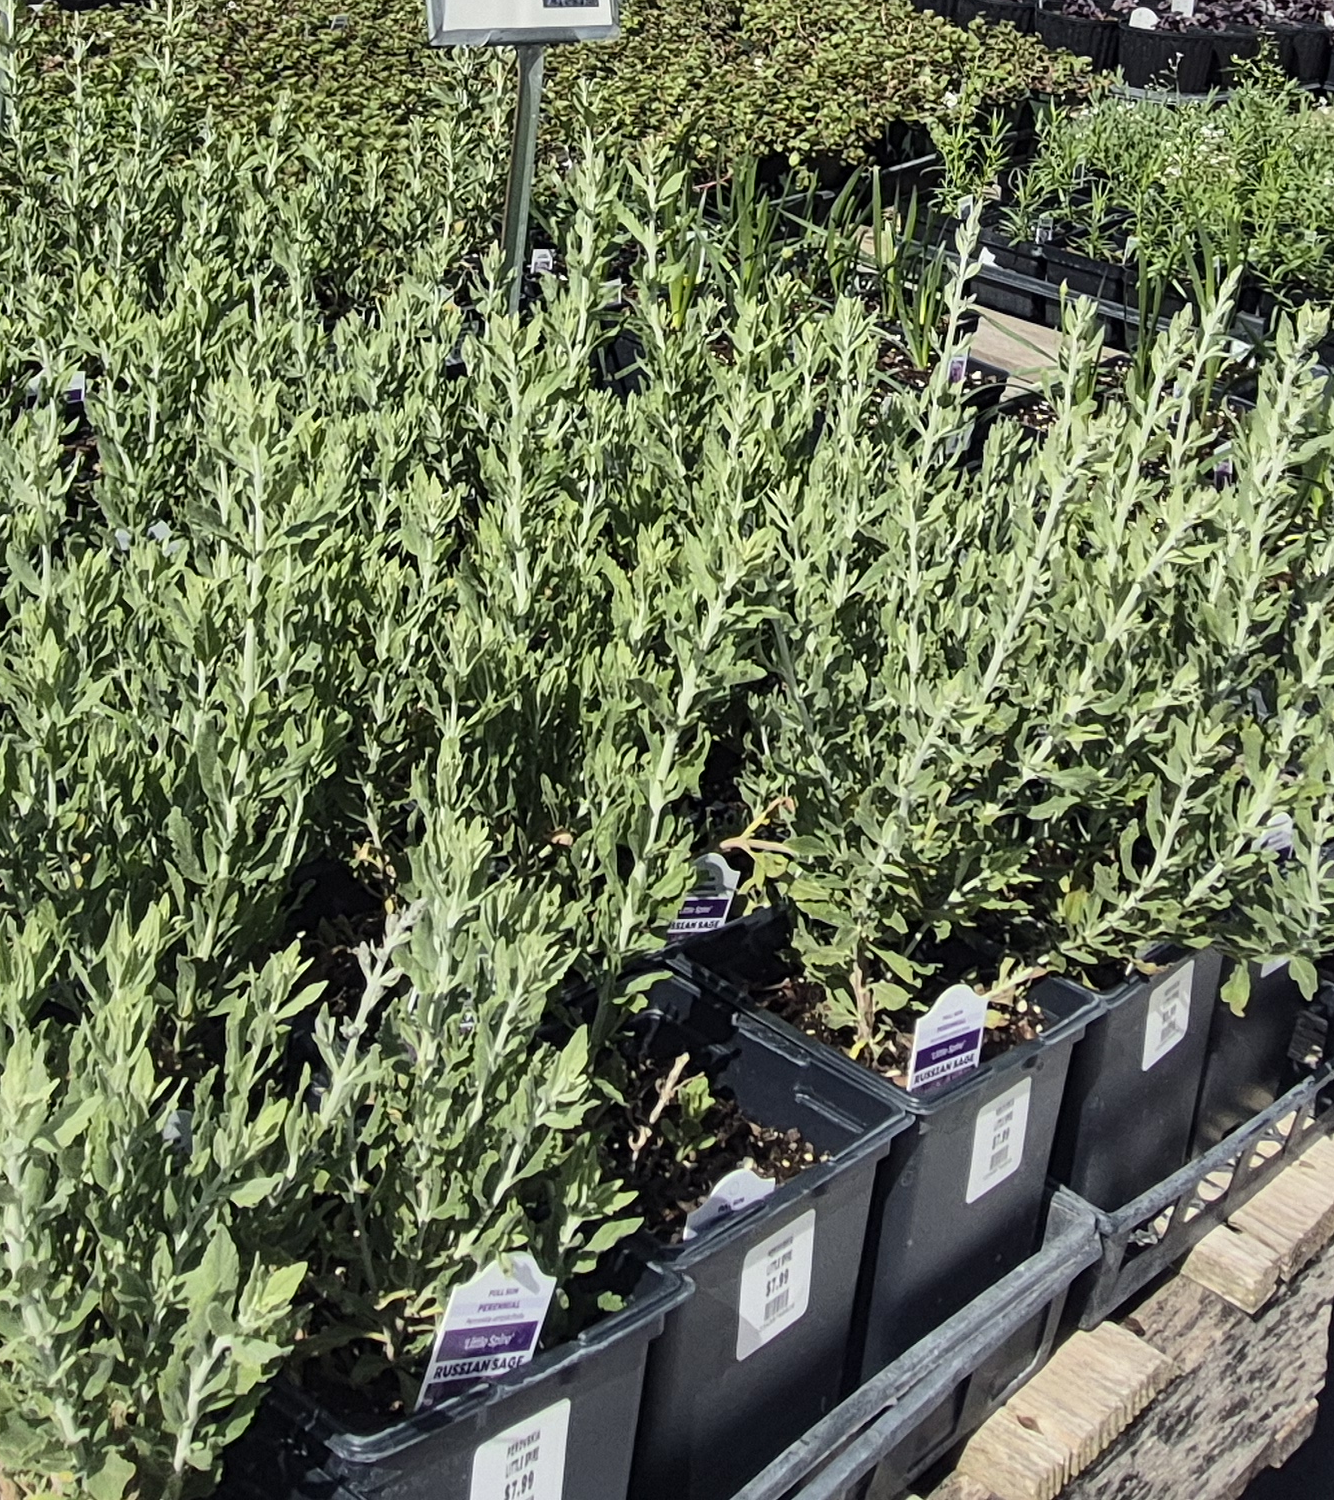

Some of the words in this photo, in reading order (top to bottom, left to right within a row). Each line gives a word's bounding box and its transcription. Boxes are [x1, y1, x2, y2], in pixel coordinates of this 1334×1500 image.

[697, 920, 720, 929] SAGE
[913, 1061, 952, 1085] RUSSIAN
[953, 1053, 976, 1071] SAGE
[766, 1268, 789, 1298] $7.99
[477, 1301, 521, 1313] PERENNIAL
[433, 1357, 492, 1380] RUSSIAN
[492, 1355, 525, 1371] SAGE
[504, 1470, 535, 1500] $7.99
